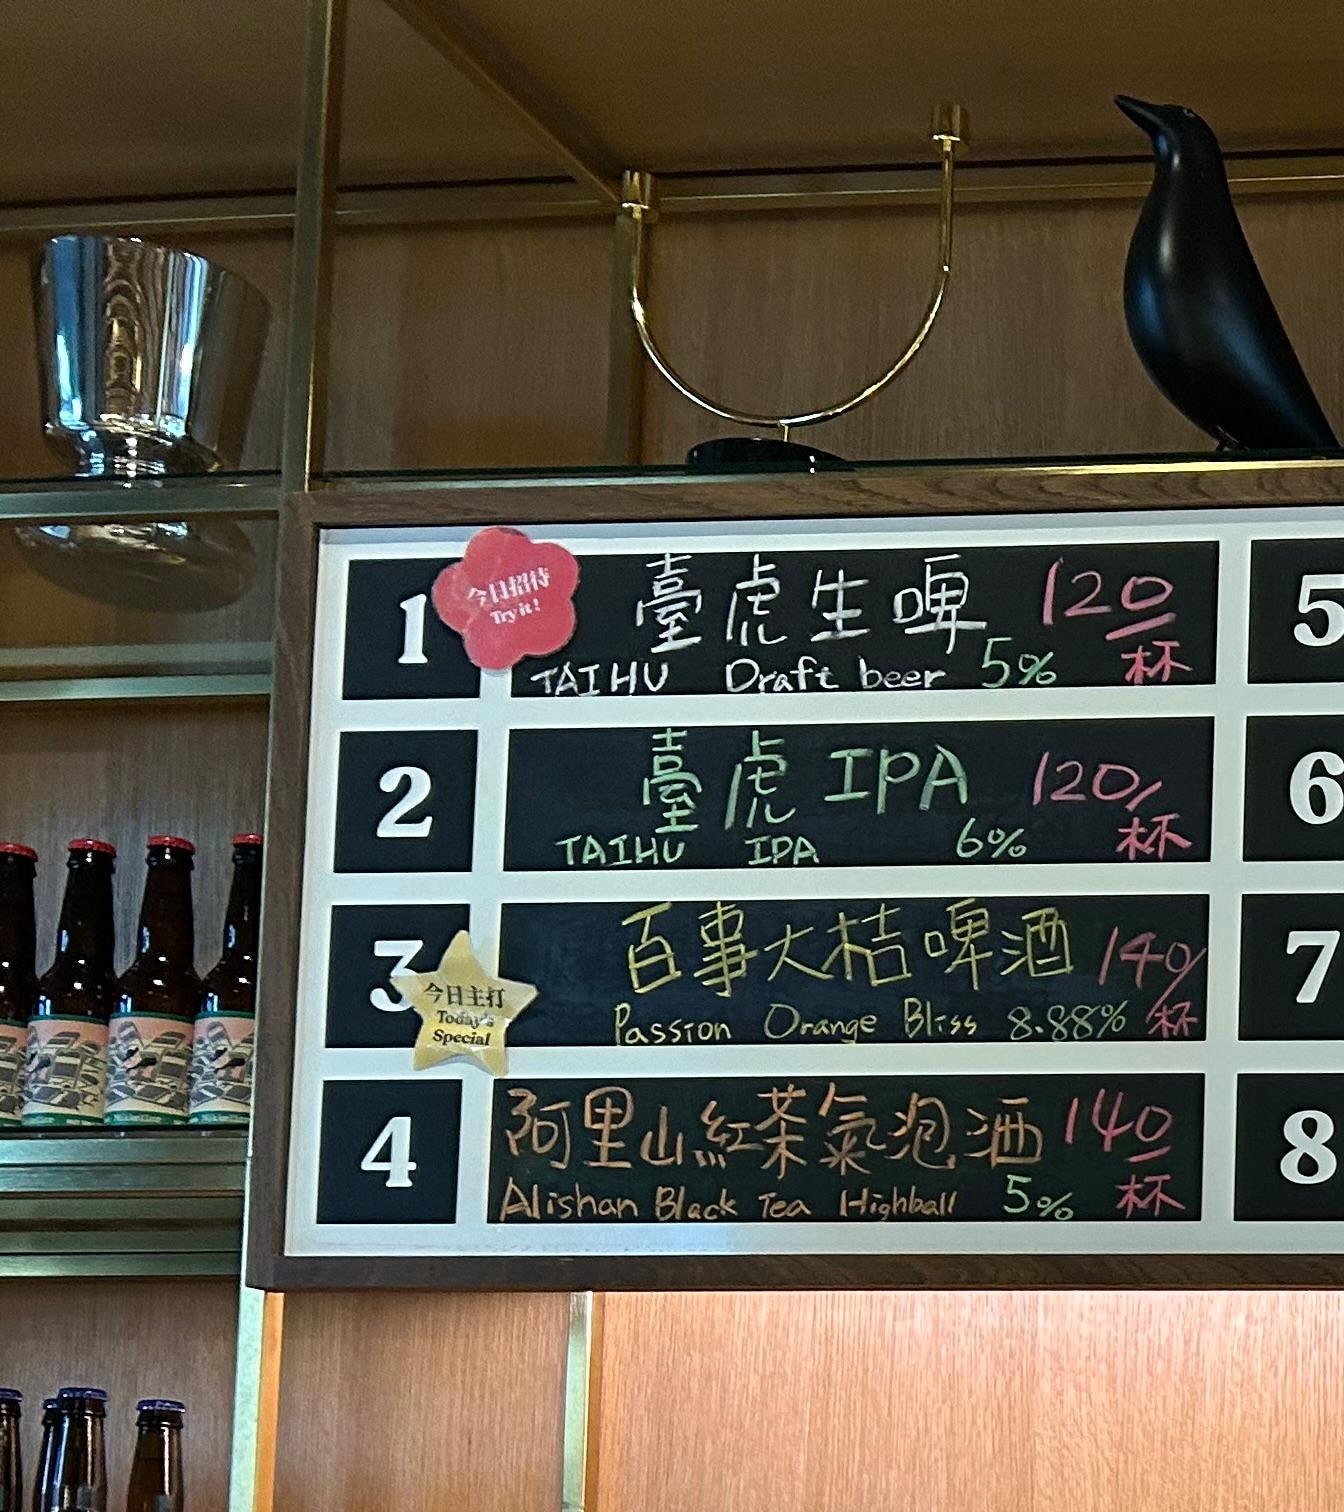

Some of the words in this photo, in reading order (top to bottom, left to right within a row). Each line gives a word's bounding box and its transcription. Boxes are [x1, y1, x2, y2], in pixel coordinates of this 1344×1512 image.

[398, 594, 428, 664] 1
[490, 609, 517, 624] Try
[530, 661, 668, 695] TAIHU
[726, 656, 839, 692] Draft
[860, 658, 946, 688] beer
[982, 637, 1056, 688] 5%
[1121, 641, 1192, 684] 杯
[377, 767, 432, 837] 2
[1290, 751, 1344, 824] 6
[555, 834, 684, 866] TAIHU
[745, 836, 819, 865] IPA
[957, 818, 1026, 858] 6%
[1117, 814, 1192, 860] 杯
[621, 901, 1075, 998] 百事大桔啤酒
[1287, 931, 1340, 1003] 7
[370, 940, 434, 1021] 3
[423, 982, 506, 1008] 今日主打
[433, 1029, 491, 1046] Special
[437, 1010, 494, 1029] Today's
[615, 1003, 731, 1044] Passion
[765, 1004, 877, 1038] Orange
[904, 998, 976, 1038] Bliss
[1008, 1001, 1127, 1040] 8.88%
[361, 1117, 416, 1187] 4
[506, 1083, 1042, 1179] 阿里山紅茶氣泡酒
[1280, 1110, 1337, 1184] 8
[500, 1177, 637, 1221] Alishan
[656, 1187, 737, 1220] Black
[759, 1193, 811, 1217] Tea
[840, 1186, 956, 1216] Highball
[1004, 1175, 1073, 1220] 5%
